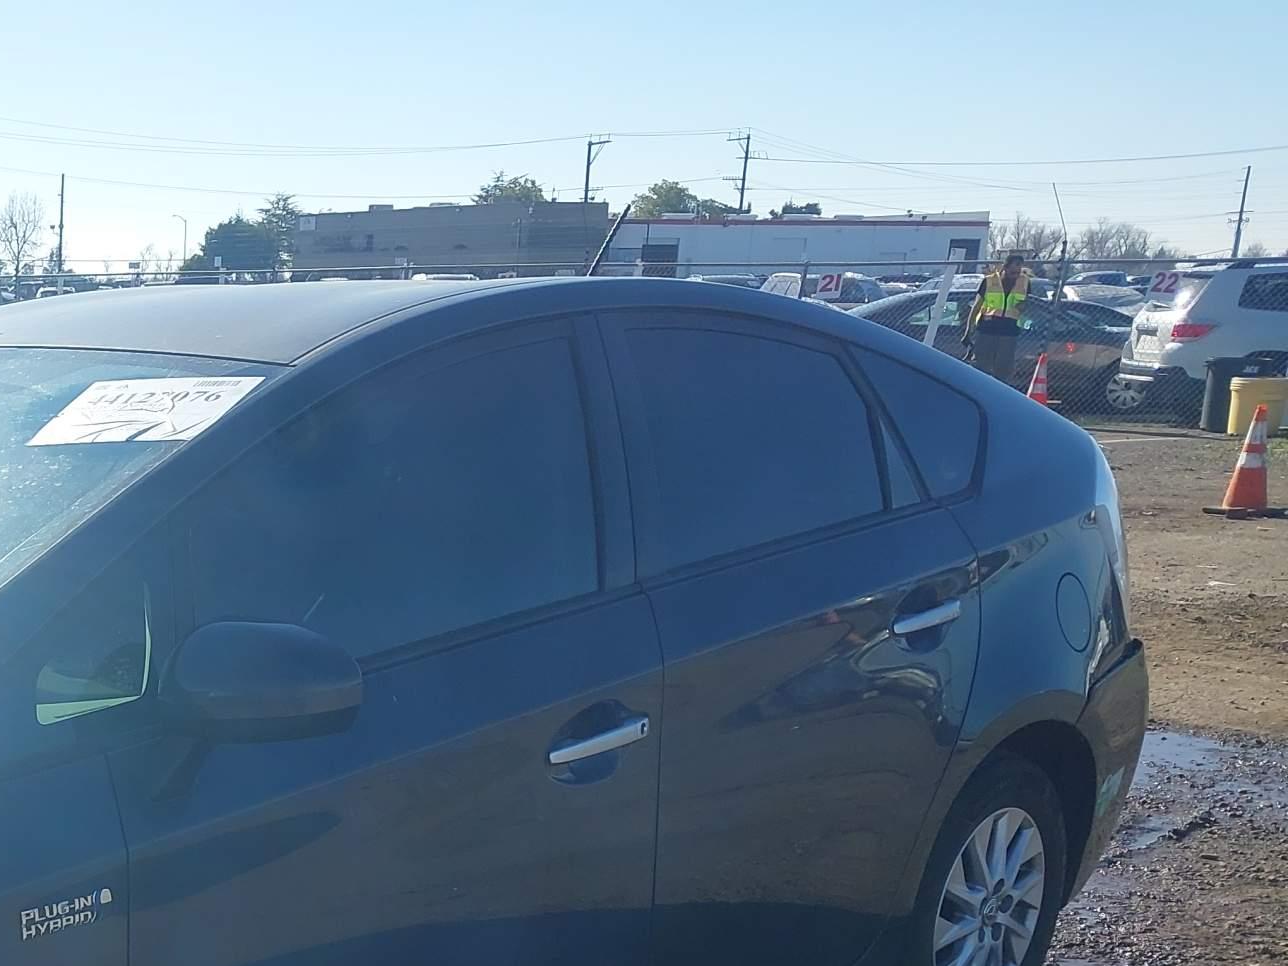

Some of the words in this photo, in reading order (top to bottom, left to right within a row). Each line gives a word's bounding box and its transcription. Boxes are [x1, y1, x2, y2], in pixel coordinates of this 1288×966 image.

[819, 273, 842, 292] 21
[1151, 271, 1180, 293] 22
[21, 895, 93, 925] PLUG-IN
[22, 911, 93, 941] HYBRID
